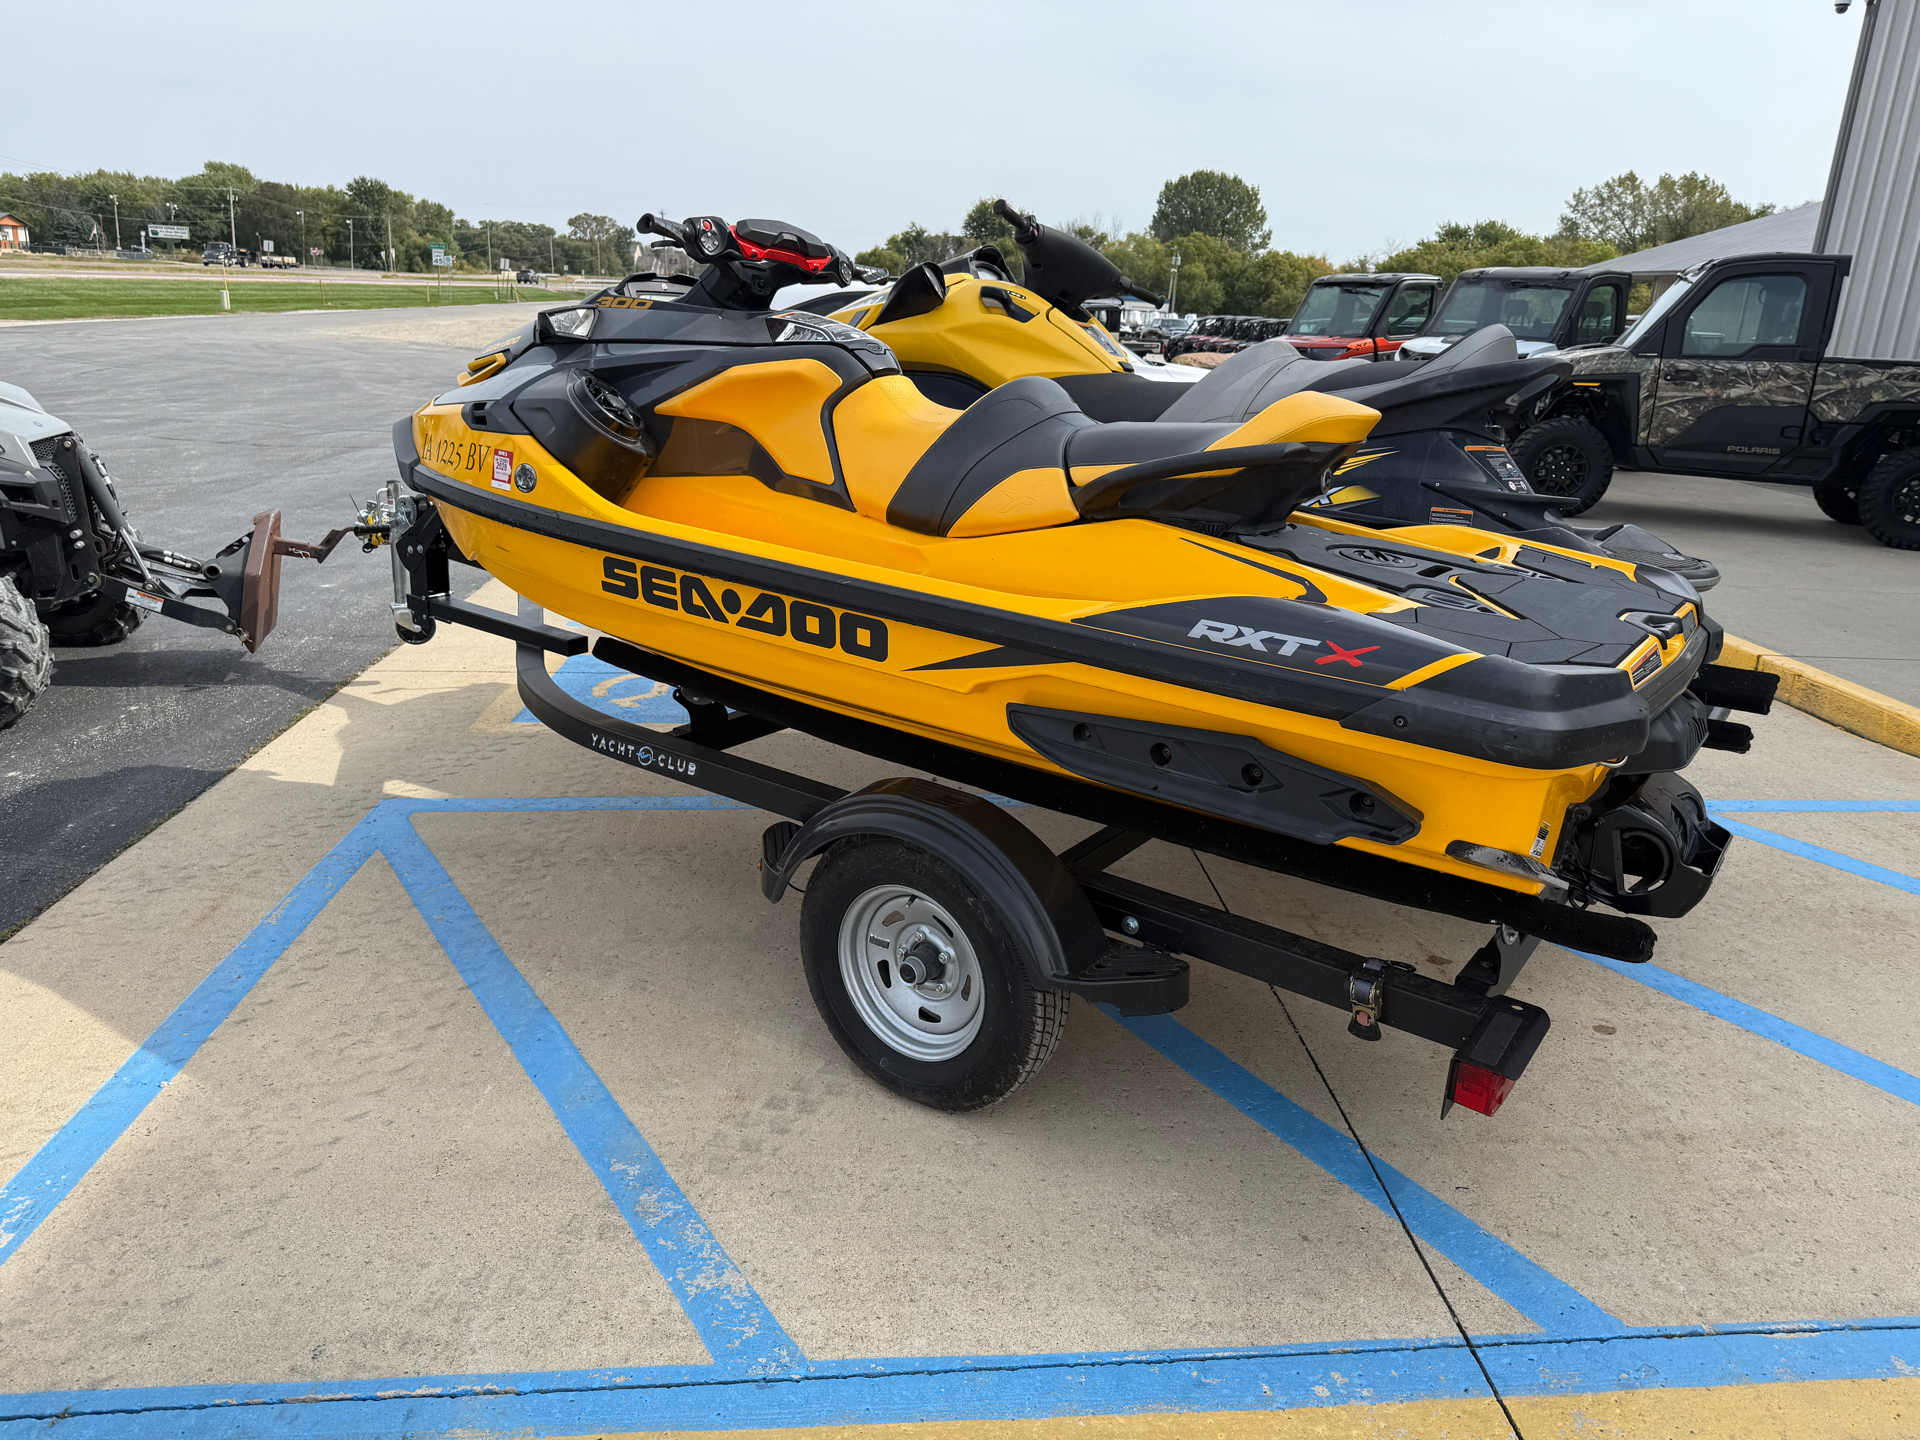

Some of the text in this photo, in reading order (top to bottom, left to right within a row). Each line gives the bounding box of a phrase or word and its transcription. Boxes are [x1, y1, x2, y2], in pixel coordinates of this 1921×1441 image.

[433, 257, 444, 265] 45
[594, 296, 654, 310] 300
[421, 433, 492, 473] IA 1225 BV
[1726, 445, 1781, 455] POLARIS
[1187, 618, 1382, 668] RXT X
[591, 733, 697, 776] YACHT CLUB
